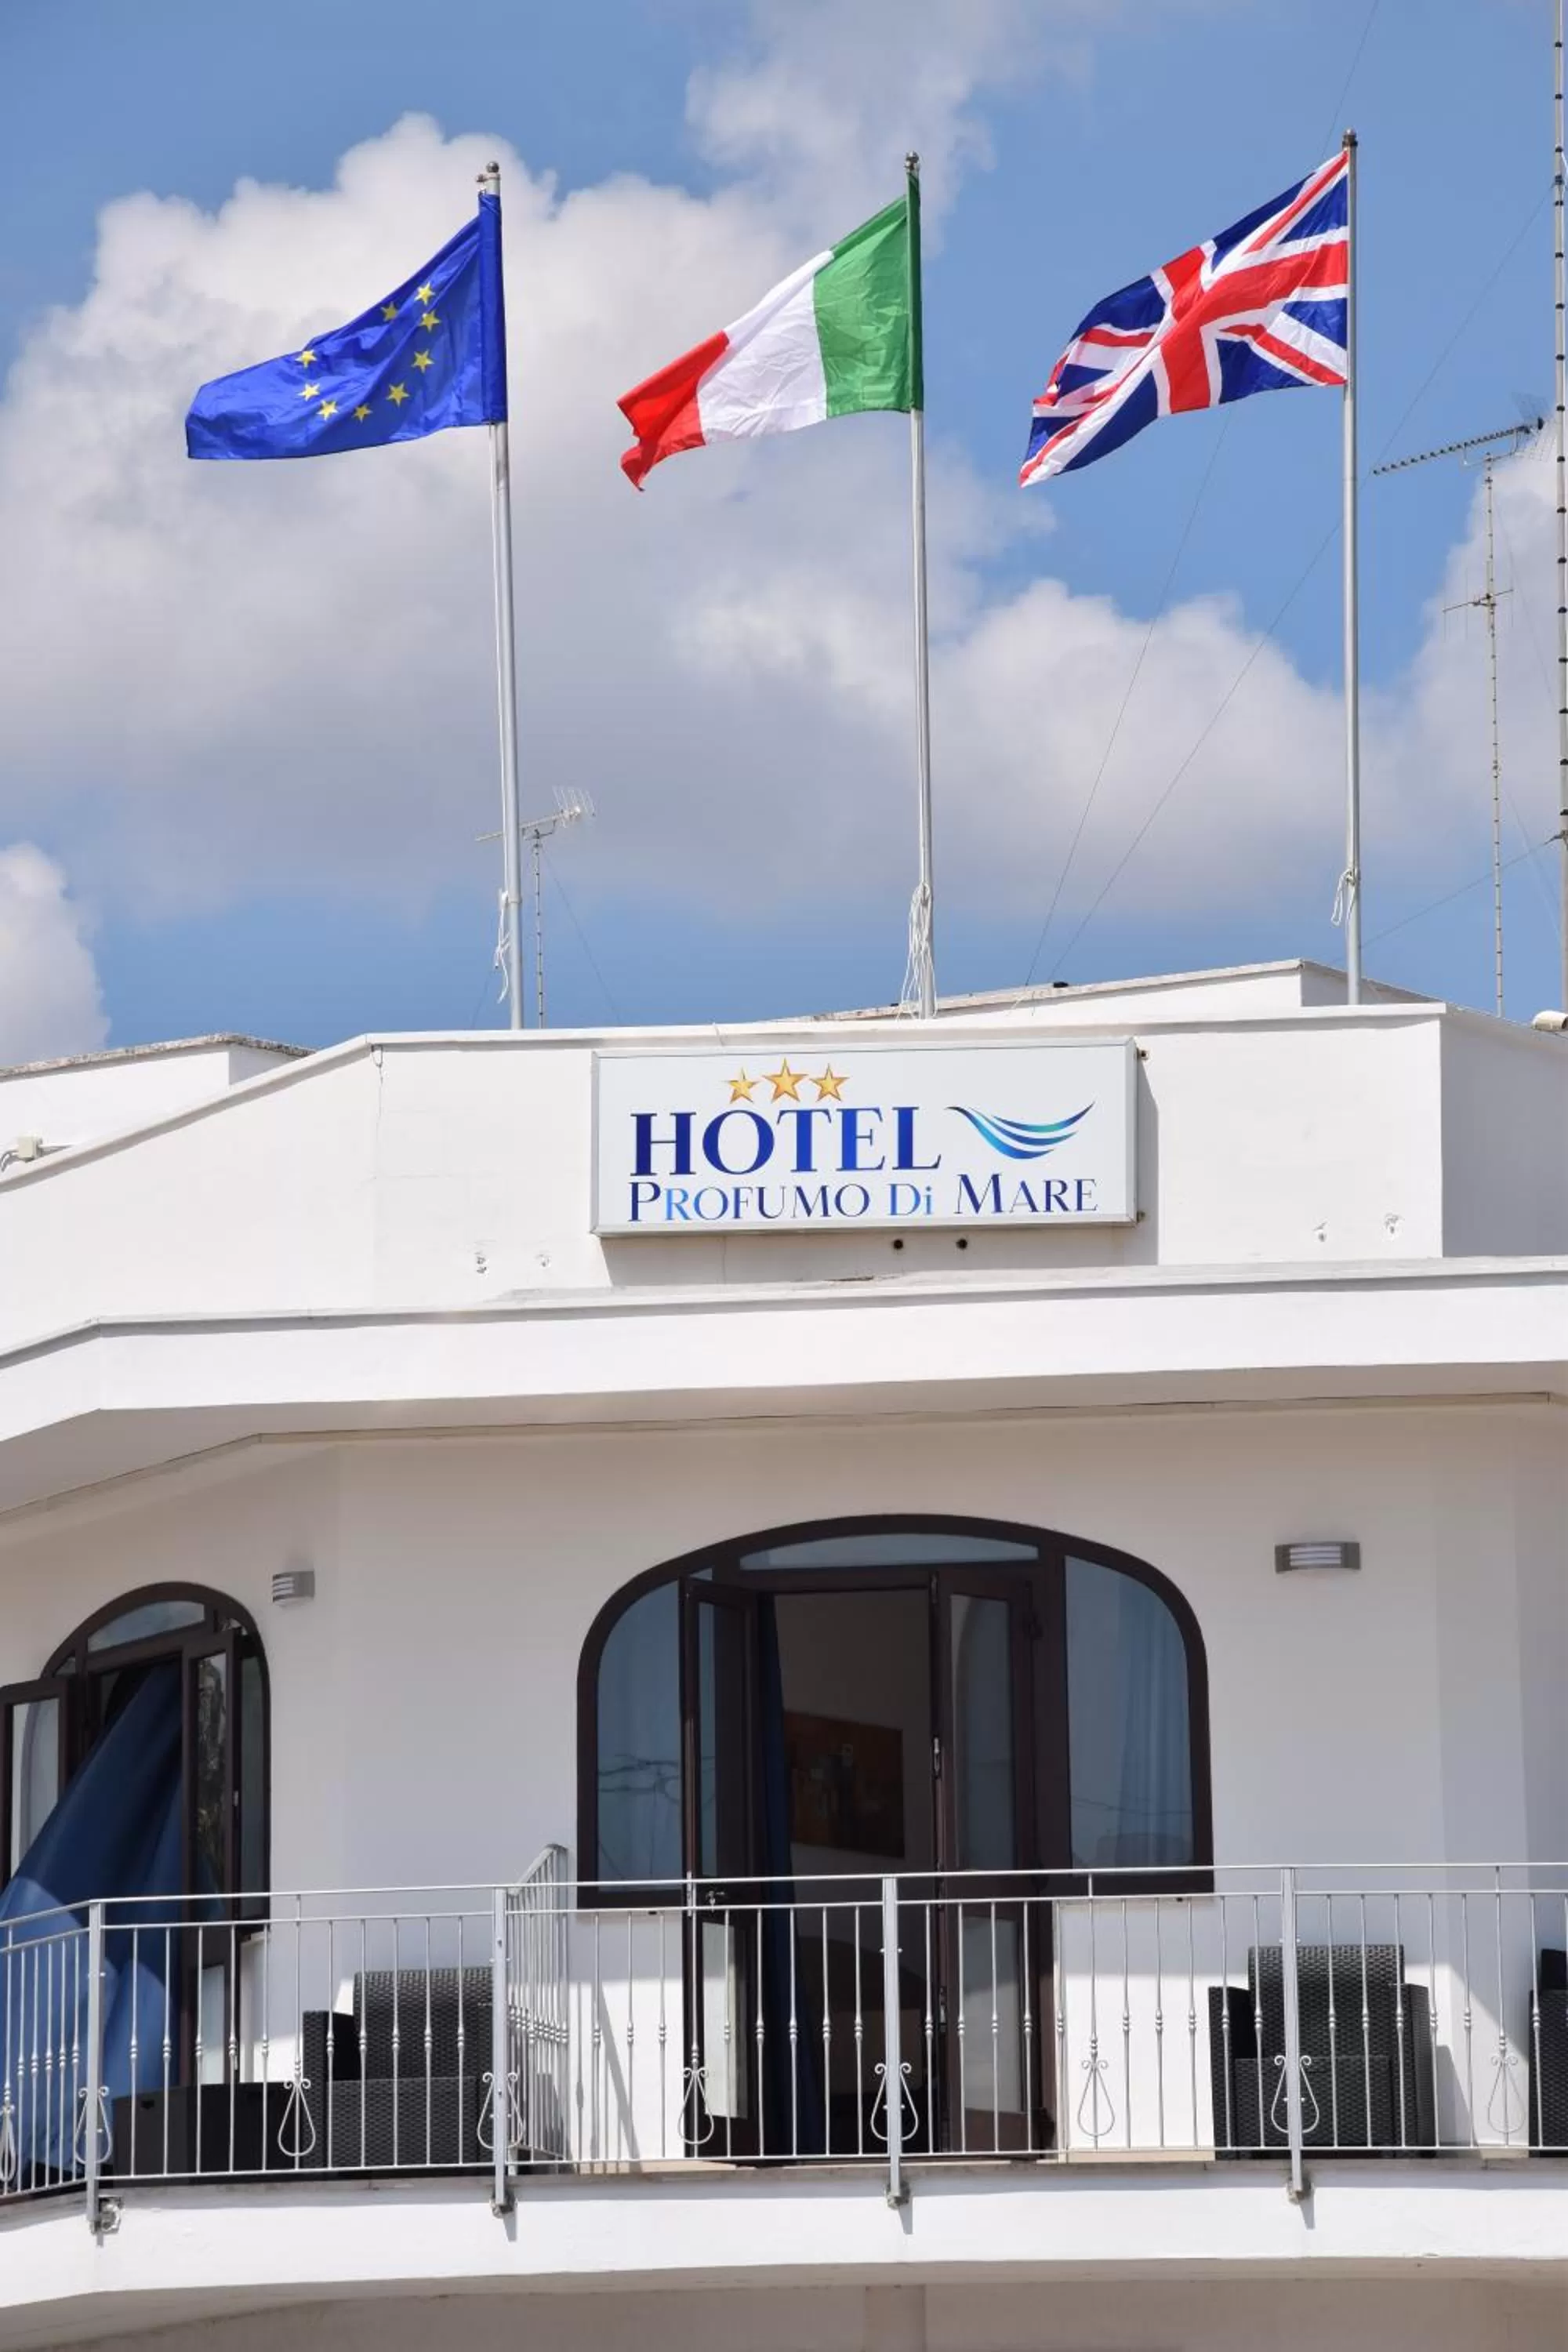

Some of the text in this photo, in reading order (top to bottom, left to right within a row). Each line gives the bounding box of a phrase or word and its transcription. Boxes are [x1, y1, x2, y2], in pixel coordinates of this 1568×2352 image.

[630, 1106, 942, 1177] HOTEL
[628, 1173, 1099, 1222] PROFUMO Di MARE
